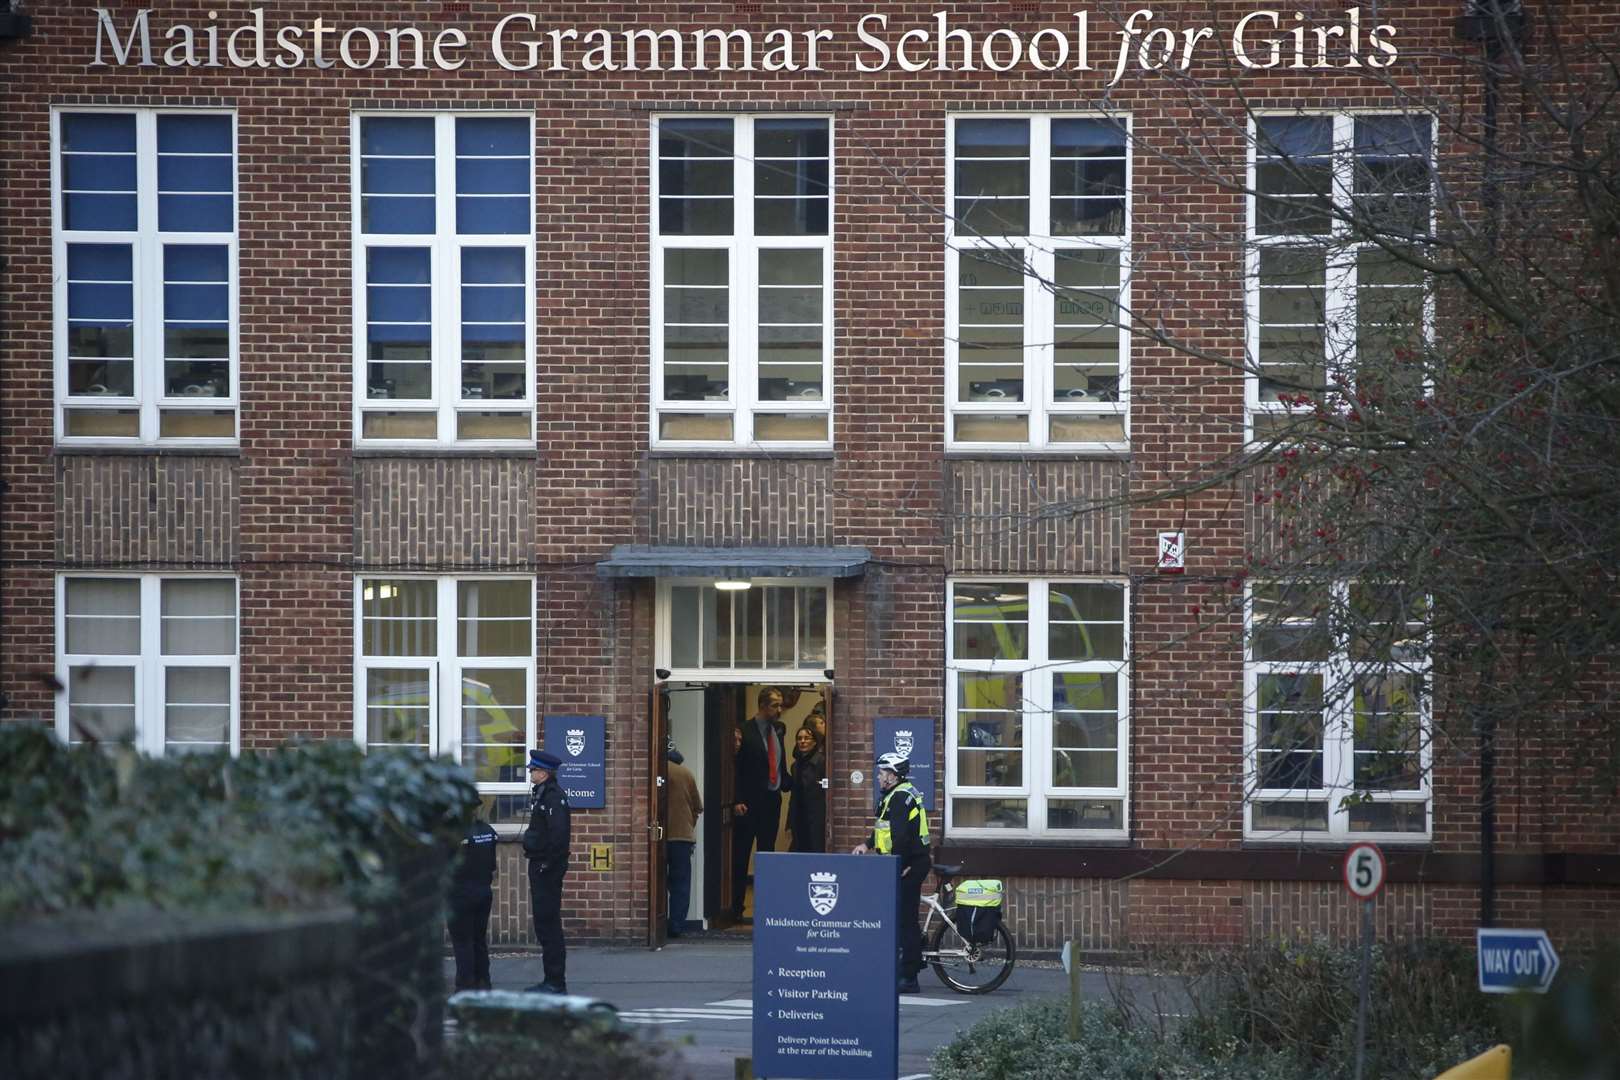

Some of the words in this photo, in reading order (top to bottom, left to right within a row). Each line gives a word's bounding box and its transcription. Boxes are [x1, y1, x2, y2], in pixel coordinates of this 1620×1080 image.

[88, 7, 470, 70] Maidstone
[490, 12, 834, 72] Grammar
[855, 10, 1093, 72] School
[1106, 9, 1214, 87] for
[1232, 6, 1399, 70] Girls
[1355, 854, 1373, 889] 5
[766, 918, 810, 928] Maidstone
[811, 918, 852, 929] Grammar
[853, 919, 882, 929] School
[807, 929, 819, 940] for
[820, 929, 841, 938] Girls
[1483, 948, 1511, 974] WAY
[1513, 948, 1539, 975] OUT
[778, 967, 826, 979] Reception
[778, 988, 810, 999] Visitor
[811, 989, 849, 1002] Parking
[778, 1009, 824, 1020] Deliveries
[777, 1035, 809, 1046] Delivery
[809, 1036, 830, 1045] Point
[831, 1036, 859, 1046] located
[777, 1047, 786, 1055] at
[786, 1046, 800, 1055] the
[800, 1048, 816, 1056] rear
[817, 1047, 827, 1056] of
[827, 1047, 840, 1056] the
[841, 1047, 873, 1058] building
